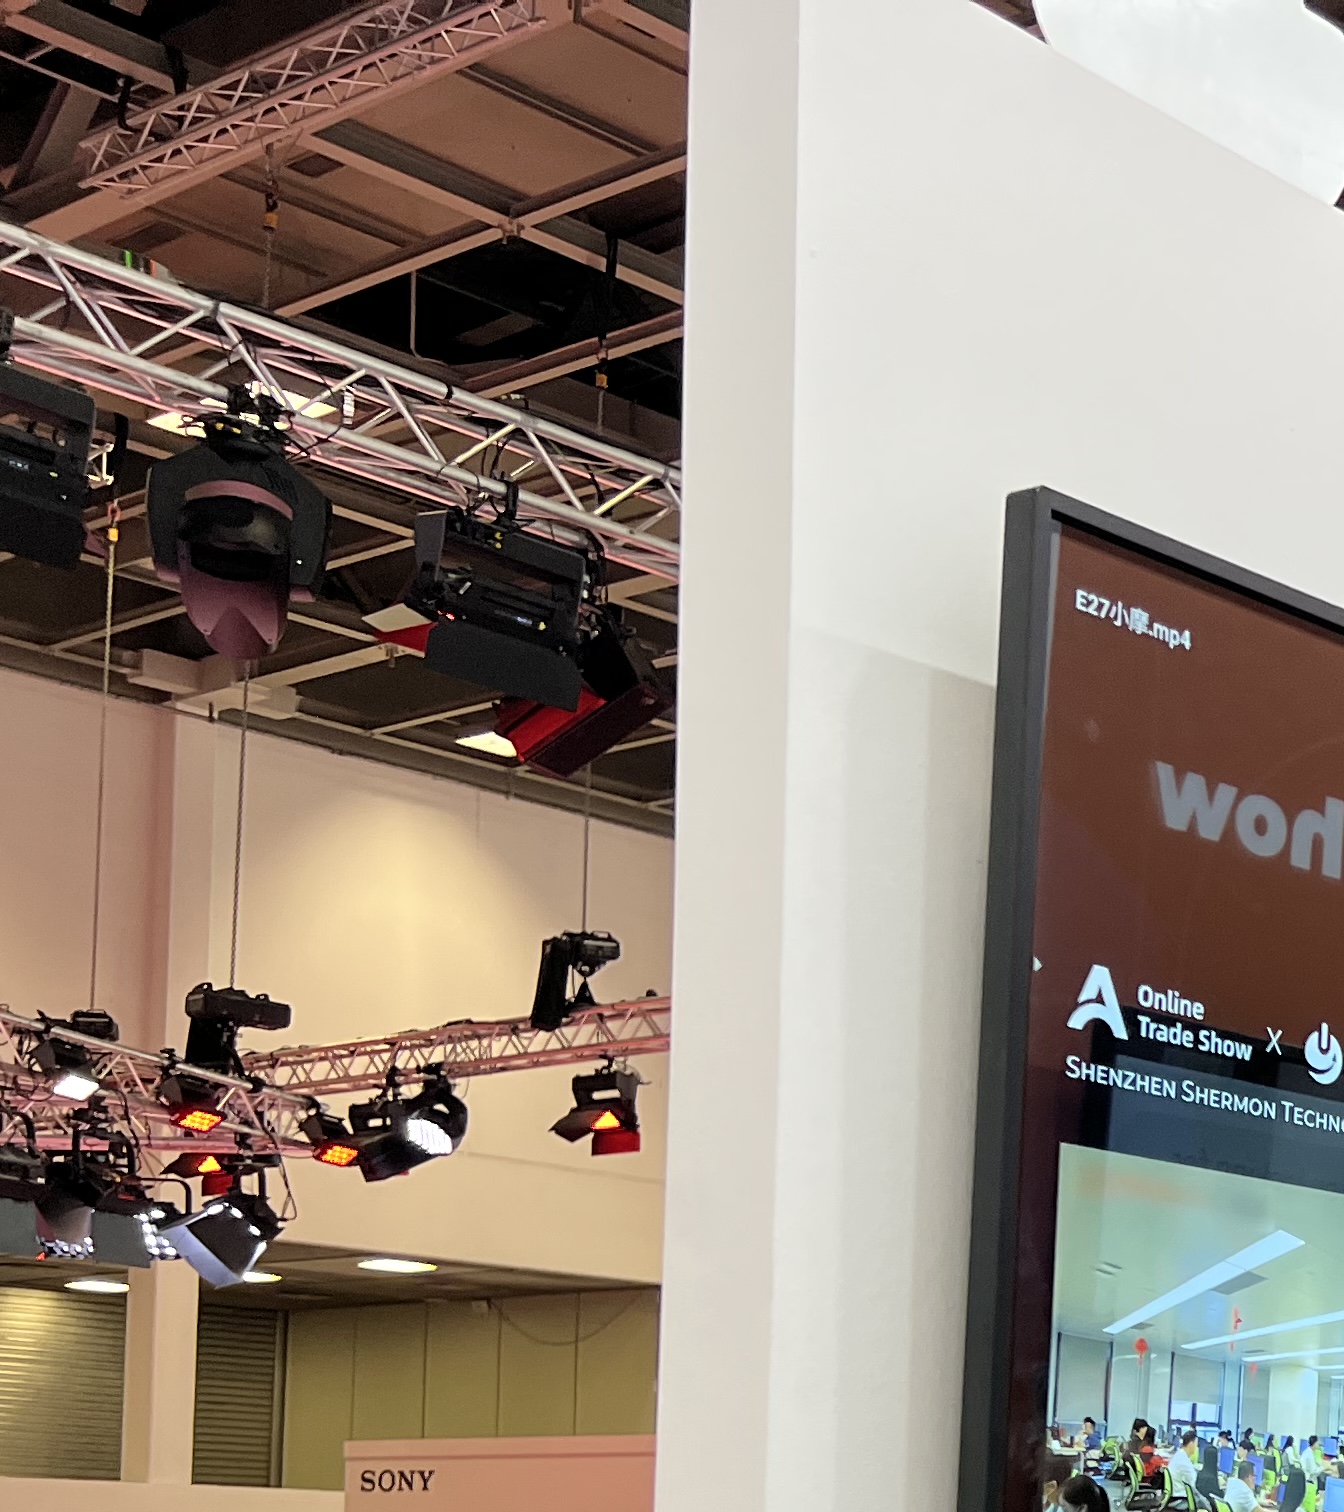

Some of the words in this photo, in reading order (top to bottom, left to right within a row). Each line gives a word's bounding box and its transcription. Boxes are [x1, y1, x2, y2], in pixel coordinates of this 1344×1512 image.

[1137, 984, 1205, 1021] Online
[1137, 1015, 1194, 1049] Trade
[1198, 1030, 1253, 1062] Show
[1065, 1054, 1177, 1100] SHENZHEN
[1180, 1080, 1277, 1120] SHERMON
[360, 1469, 435, 1493] SONY
